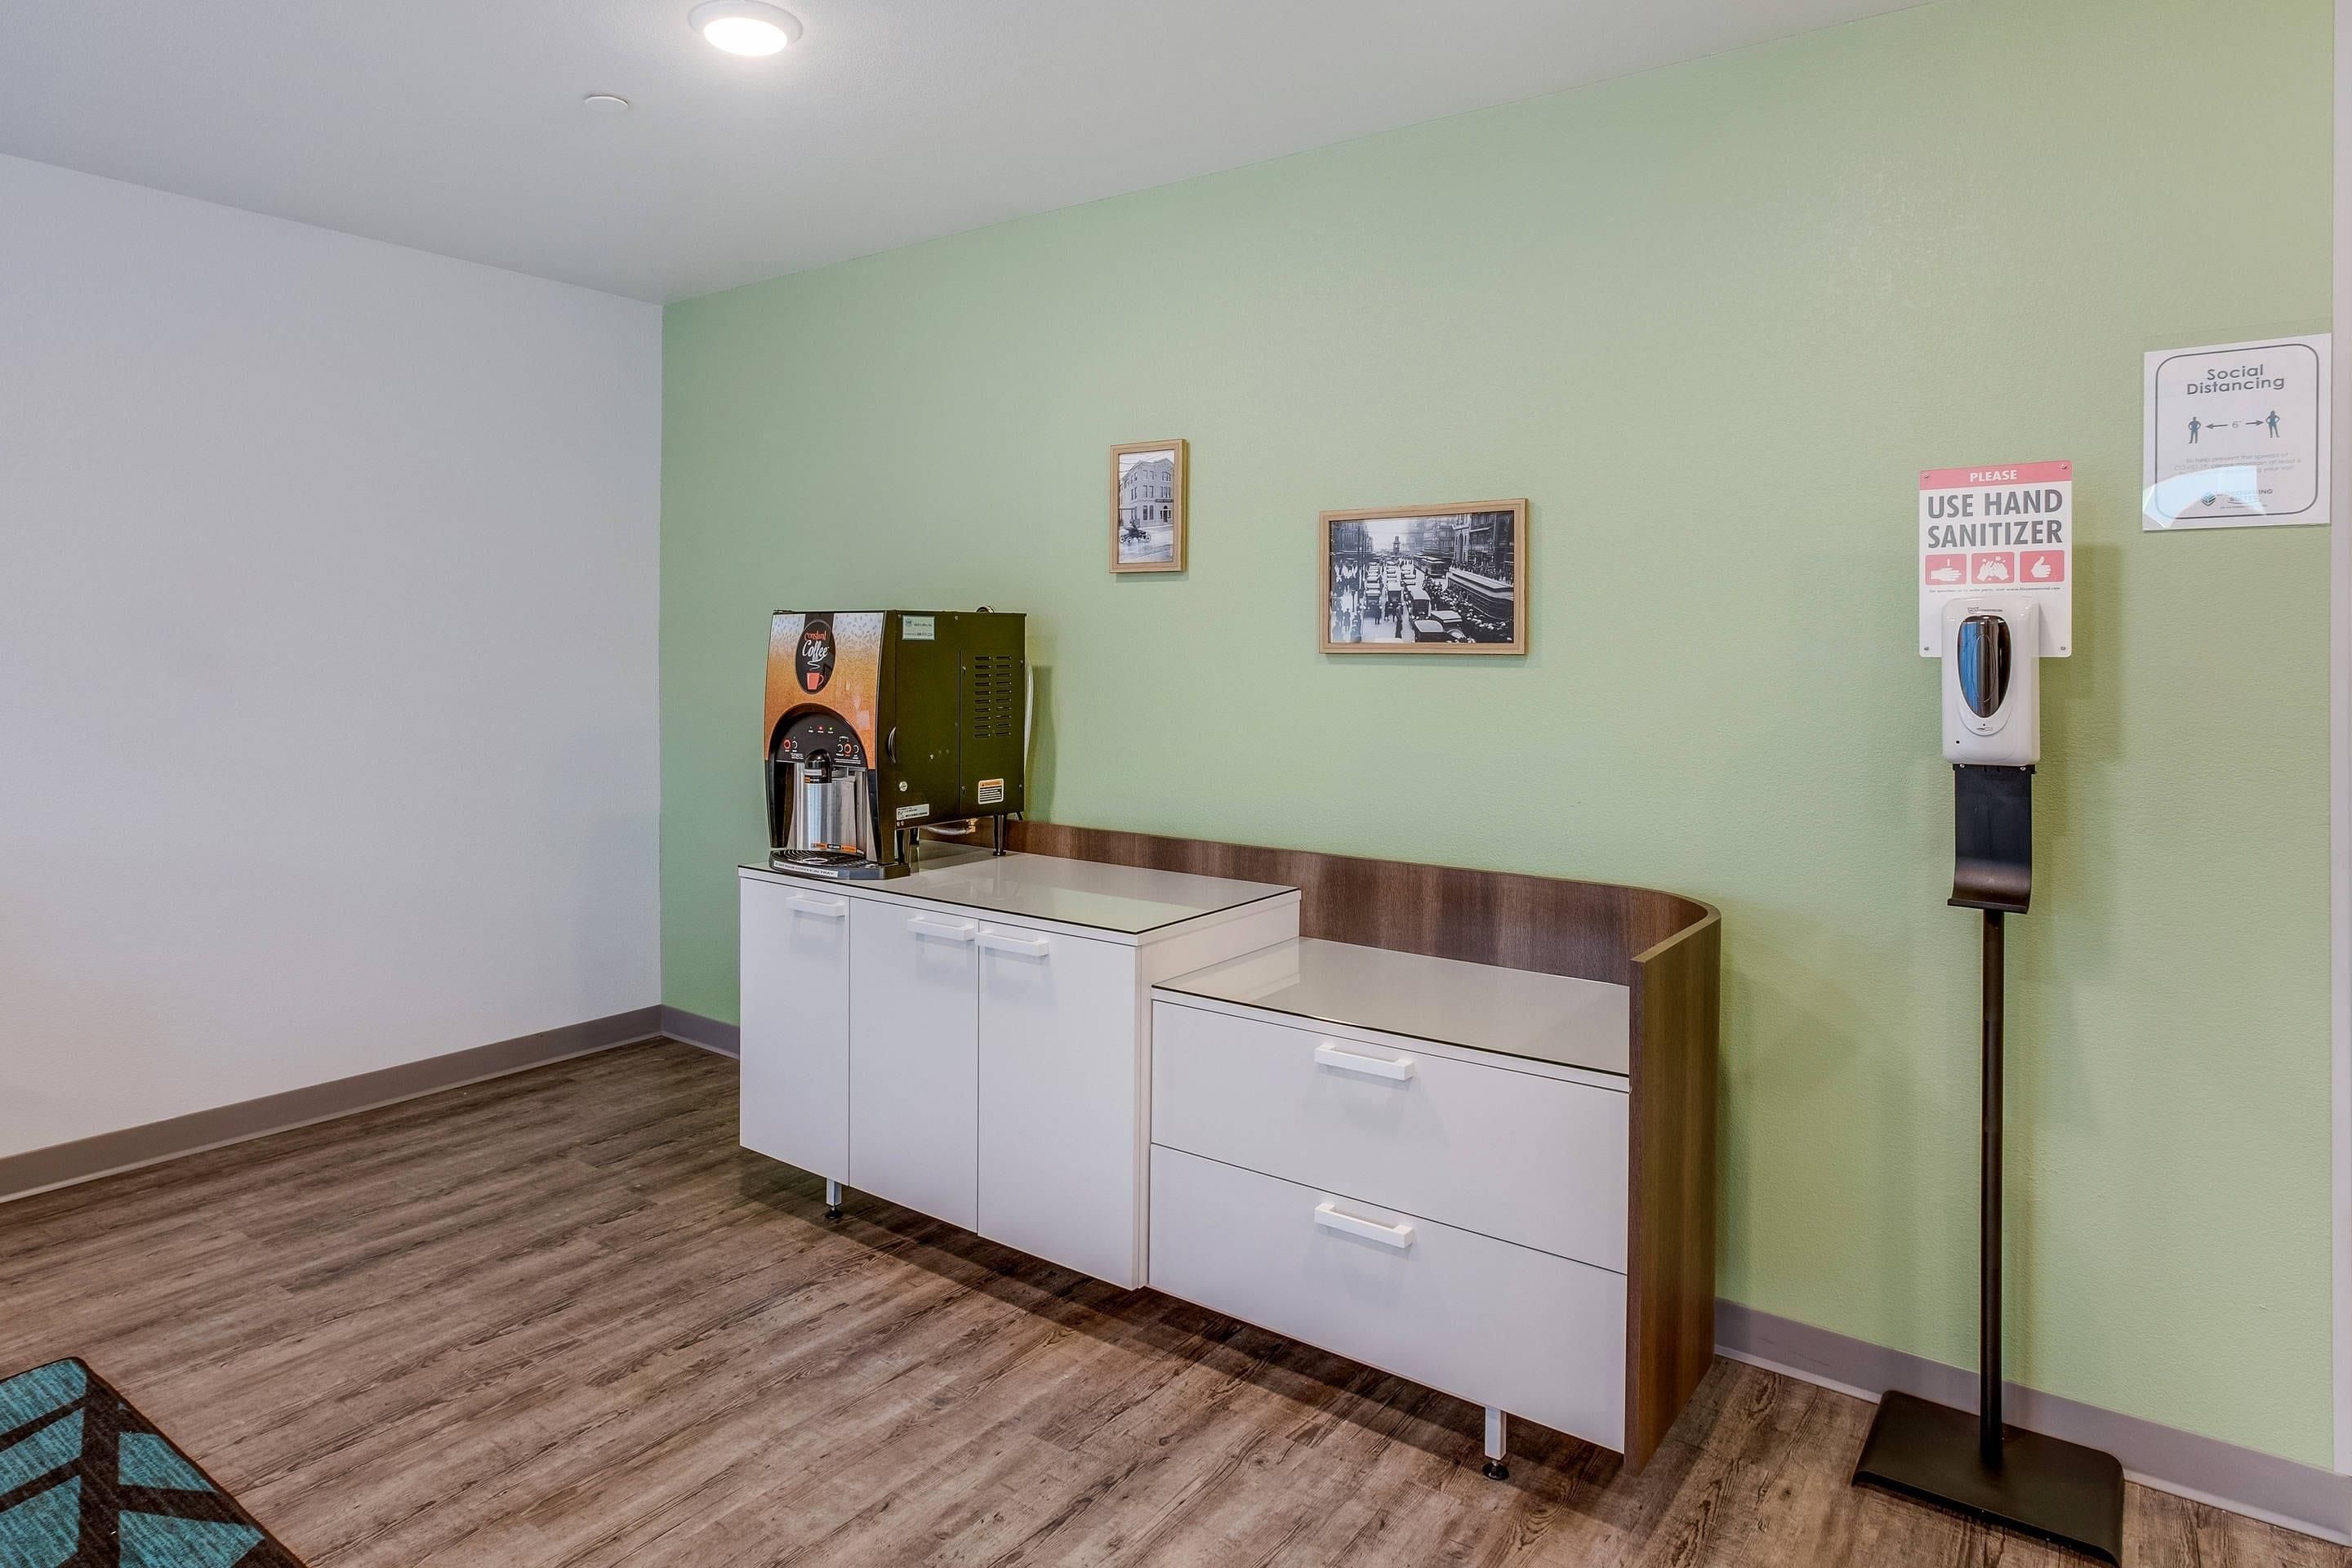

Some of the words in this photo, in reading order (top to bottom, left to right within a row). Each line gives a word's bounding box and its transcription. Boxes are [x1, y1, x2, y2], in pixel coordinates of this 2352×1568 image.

[2207, 364, 2264, 381] Social
[2187, 377, 2285, 395] Distancing
[1969, 470, 2017, 483] PLEASE
[1927, 494, 1974, 519] USE
[1984, 489, 2063, 516] HAND
[1927, 519, 2063, 549] SANITIZER
[802, 639, 828, 662] Coffee
